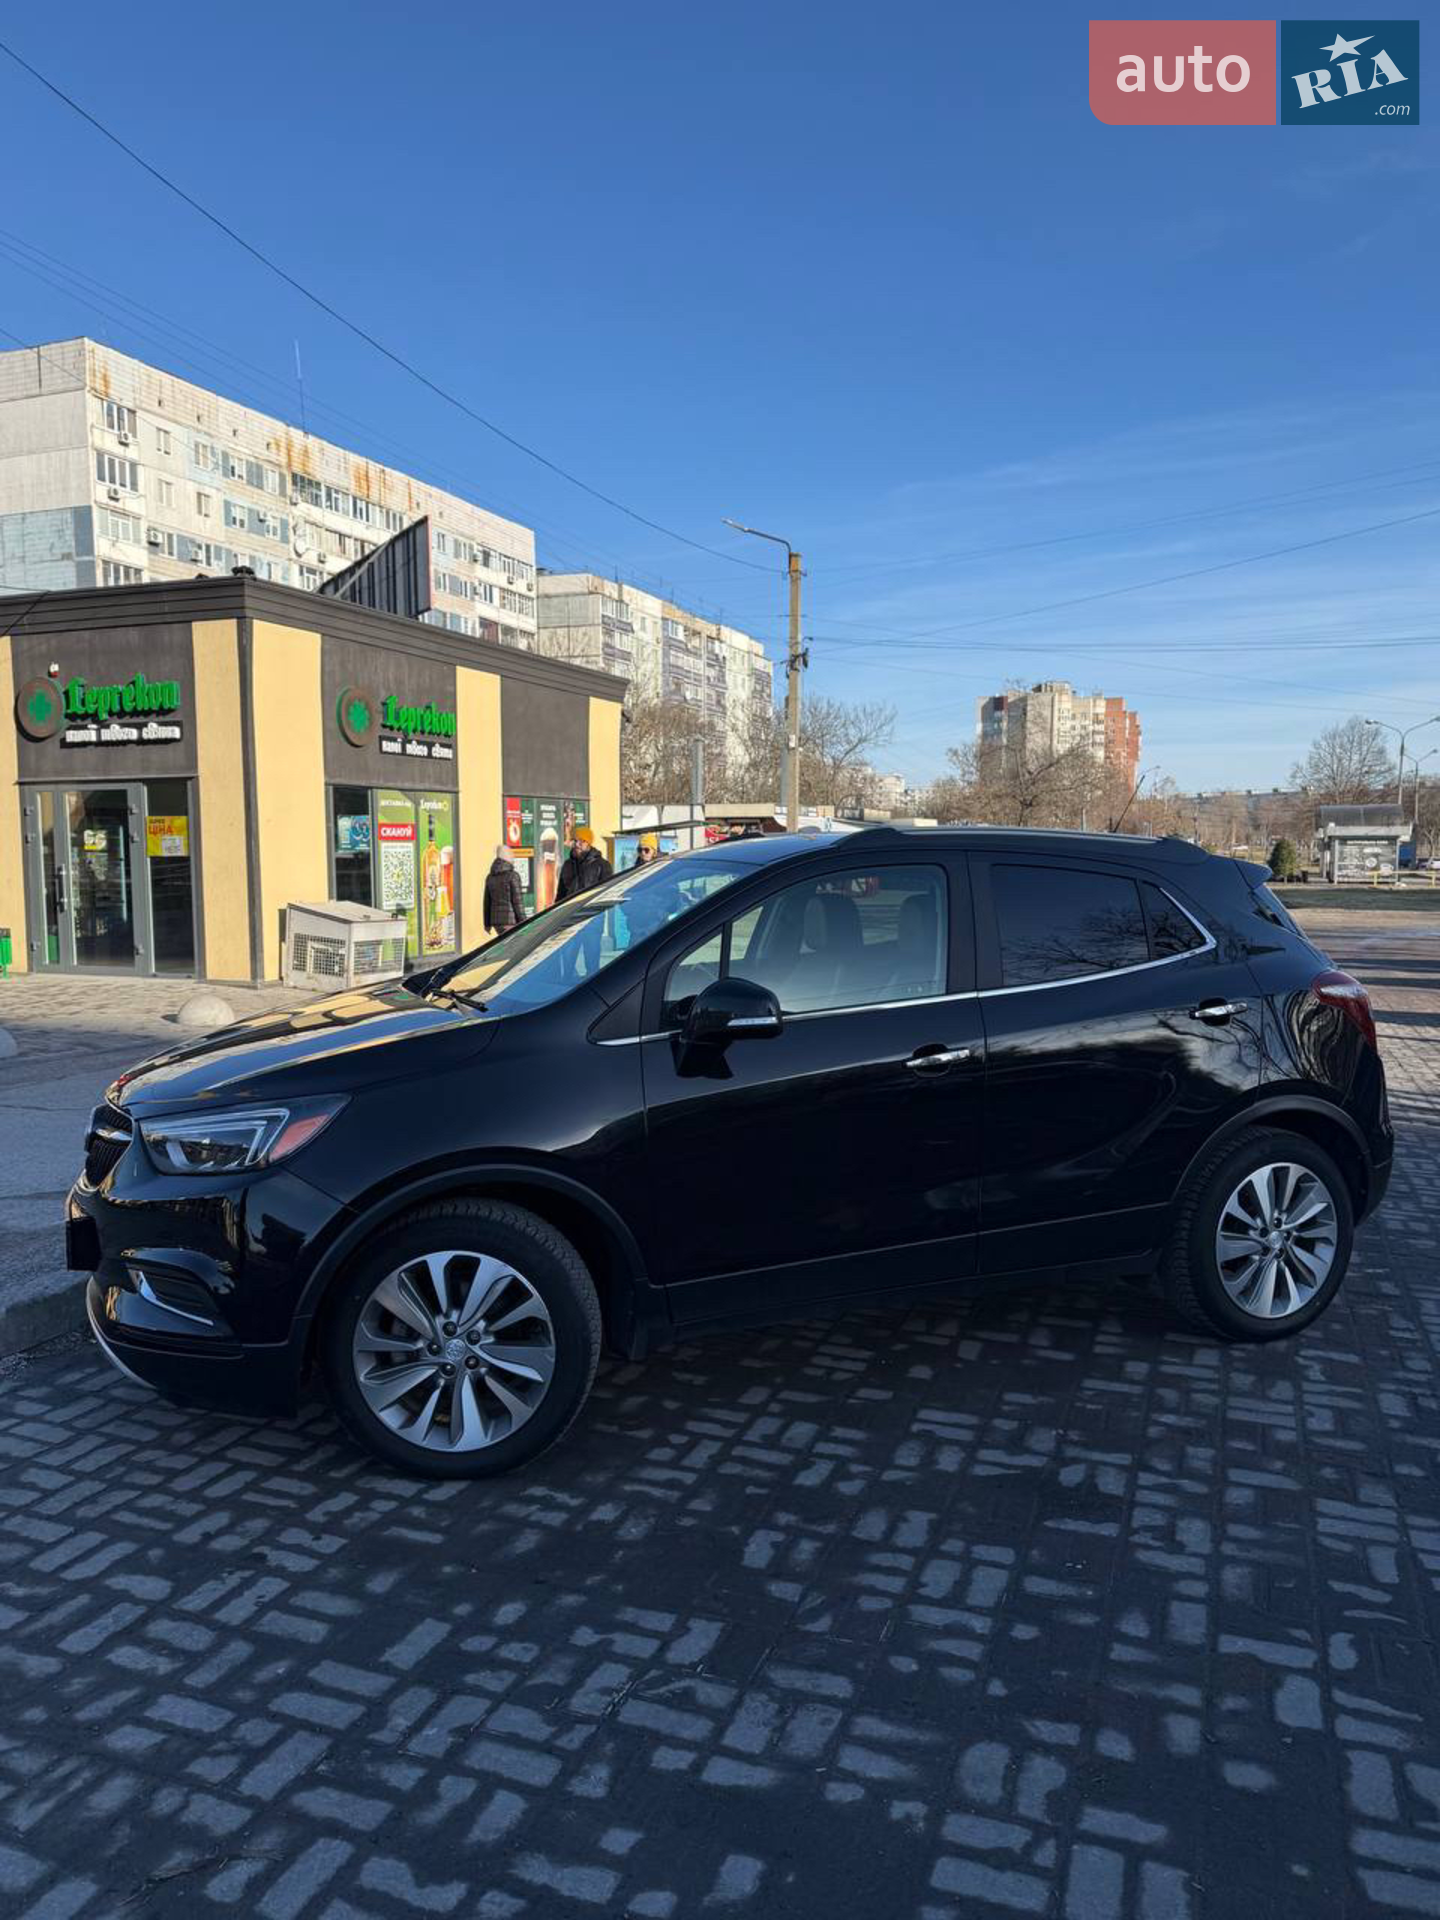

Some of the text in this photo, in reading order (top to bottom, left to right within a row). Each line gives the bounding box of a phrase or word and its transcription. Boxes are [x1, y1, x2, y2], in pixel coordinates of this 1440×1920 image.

[66, 672, 181, 720] Leprekon
[383, 695, 456, 739] Leprekon
[381, 825, 413, 838] СКАНУЙ
